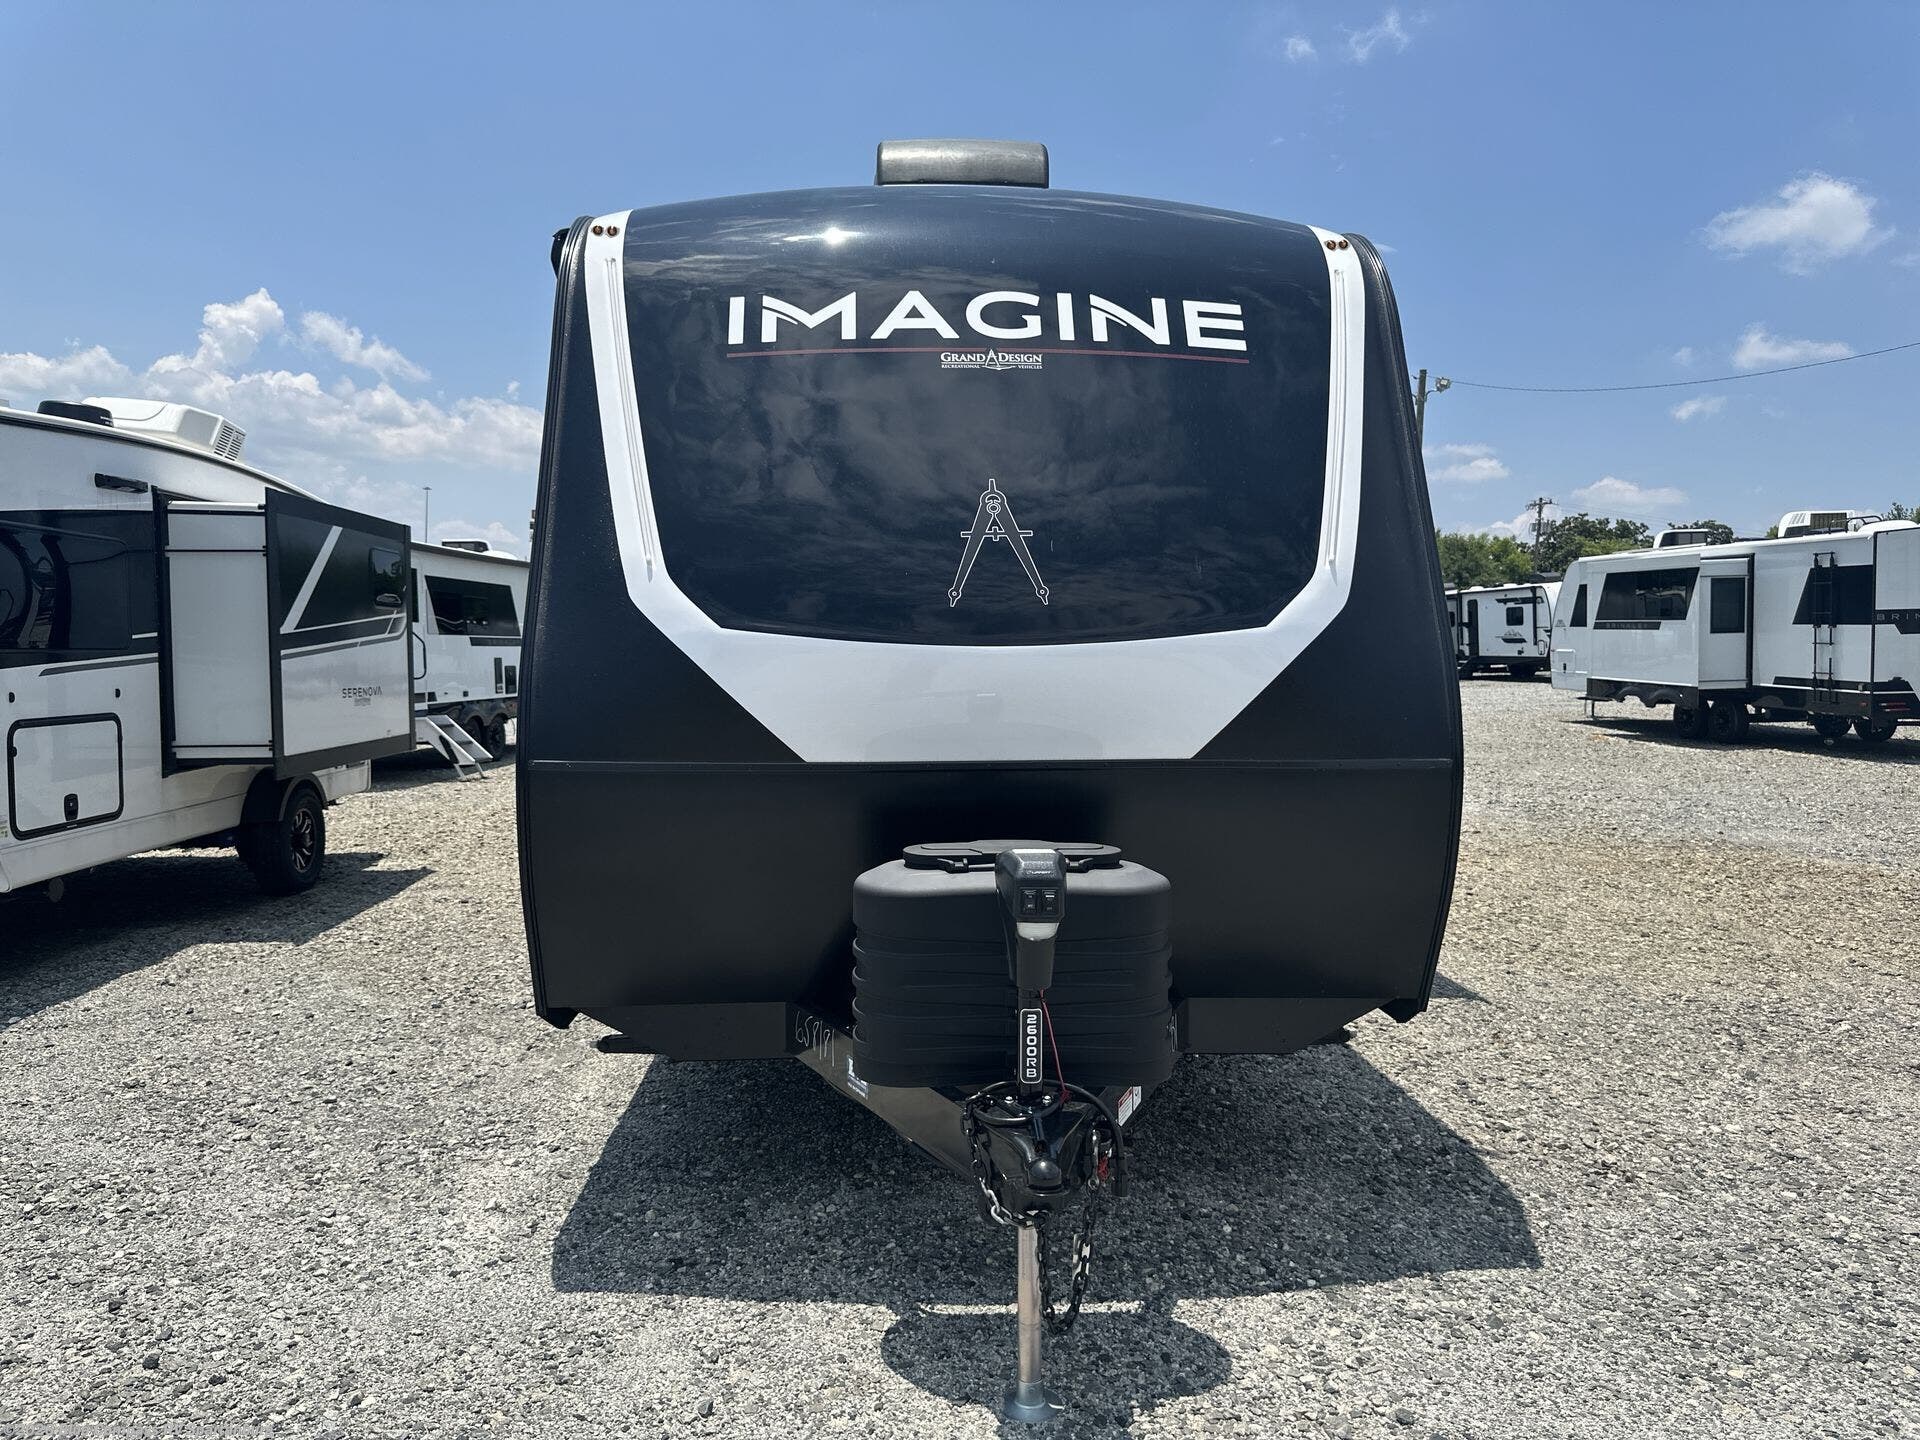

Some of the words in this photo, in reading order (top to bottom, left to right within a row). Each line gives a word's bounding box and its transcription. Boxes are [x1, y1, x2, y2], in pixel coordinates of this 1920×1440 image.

[728, 290, 1247, 351] IMAGINE
[940, 352, 986, 362] GRAND
[998, 352, 1043, 363] DESIGN
[342, 686, 383, 698] SERENOVA
[1026, 1014, 1037, 1078] 2600RB
